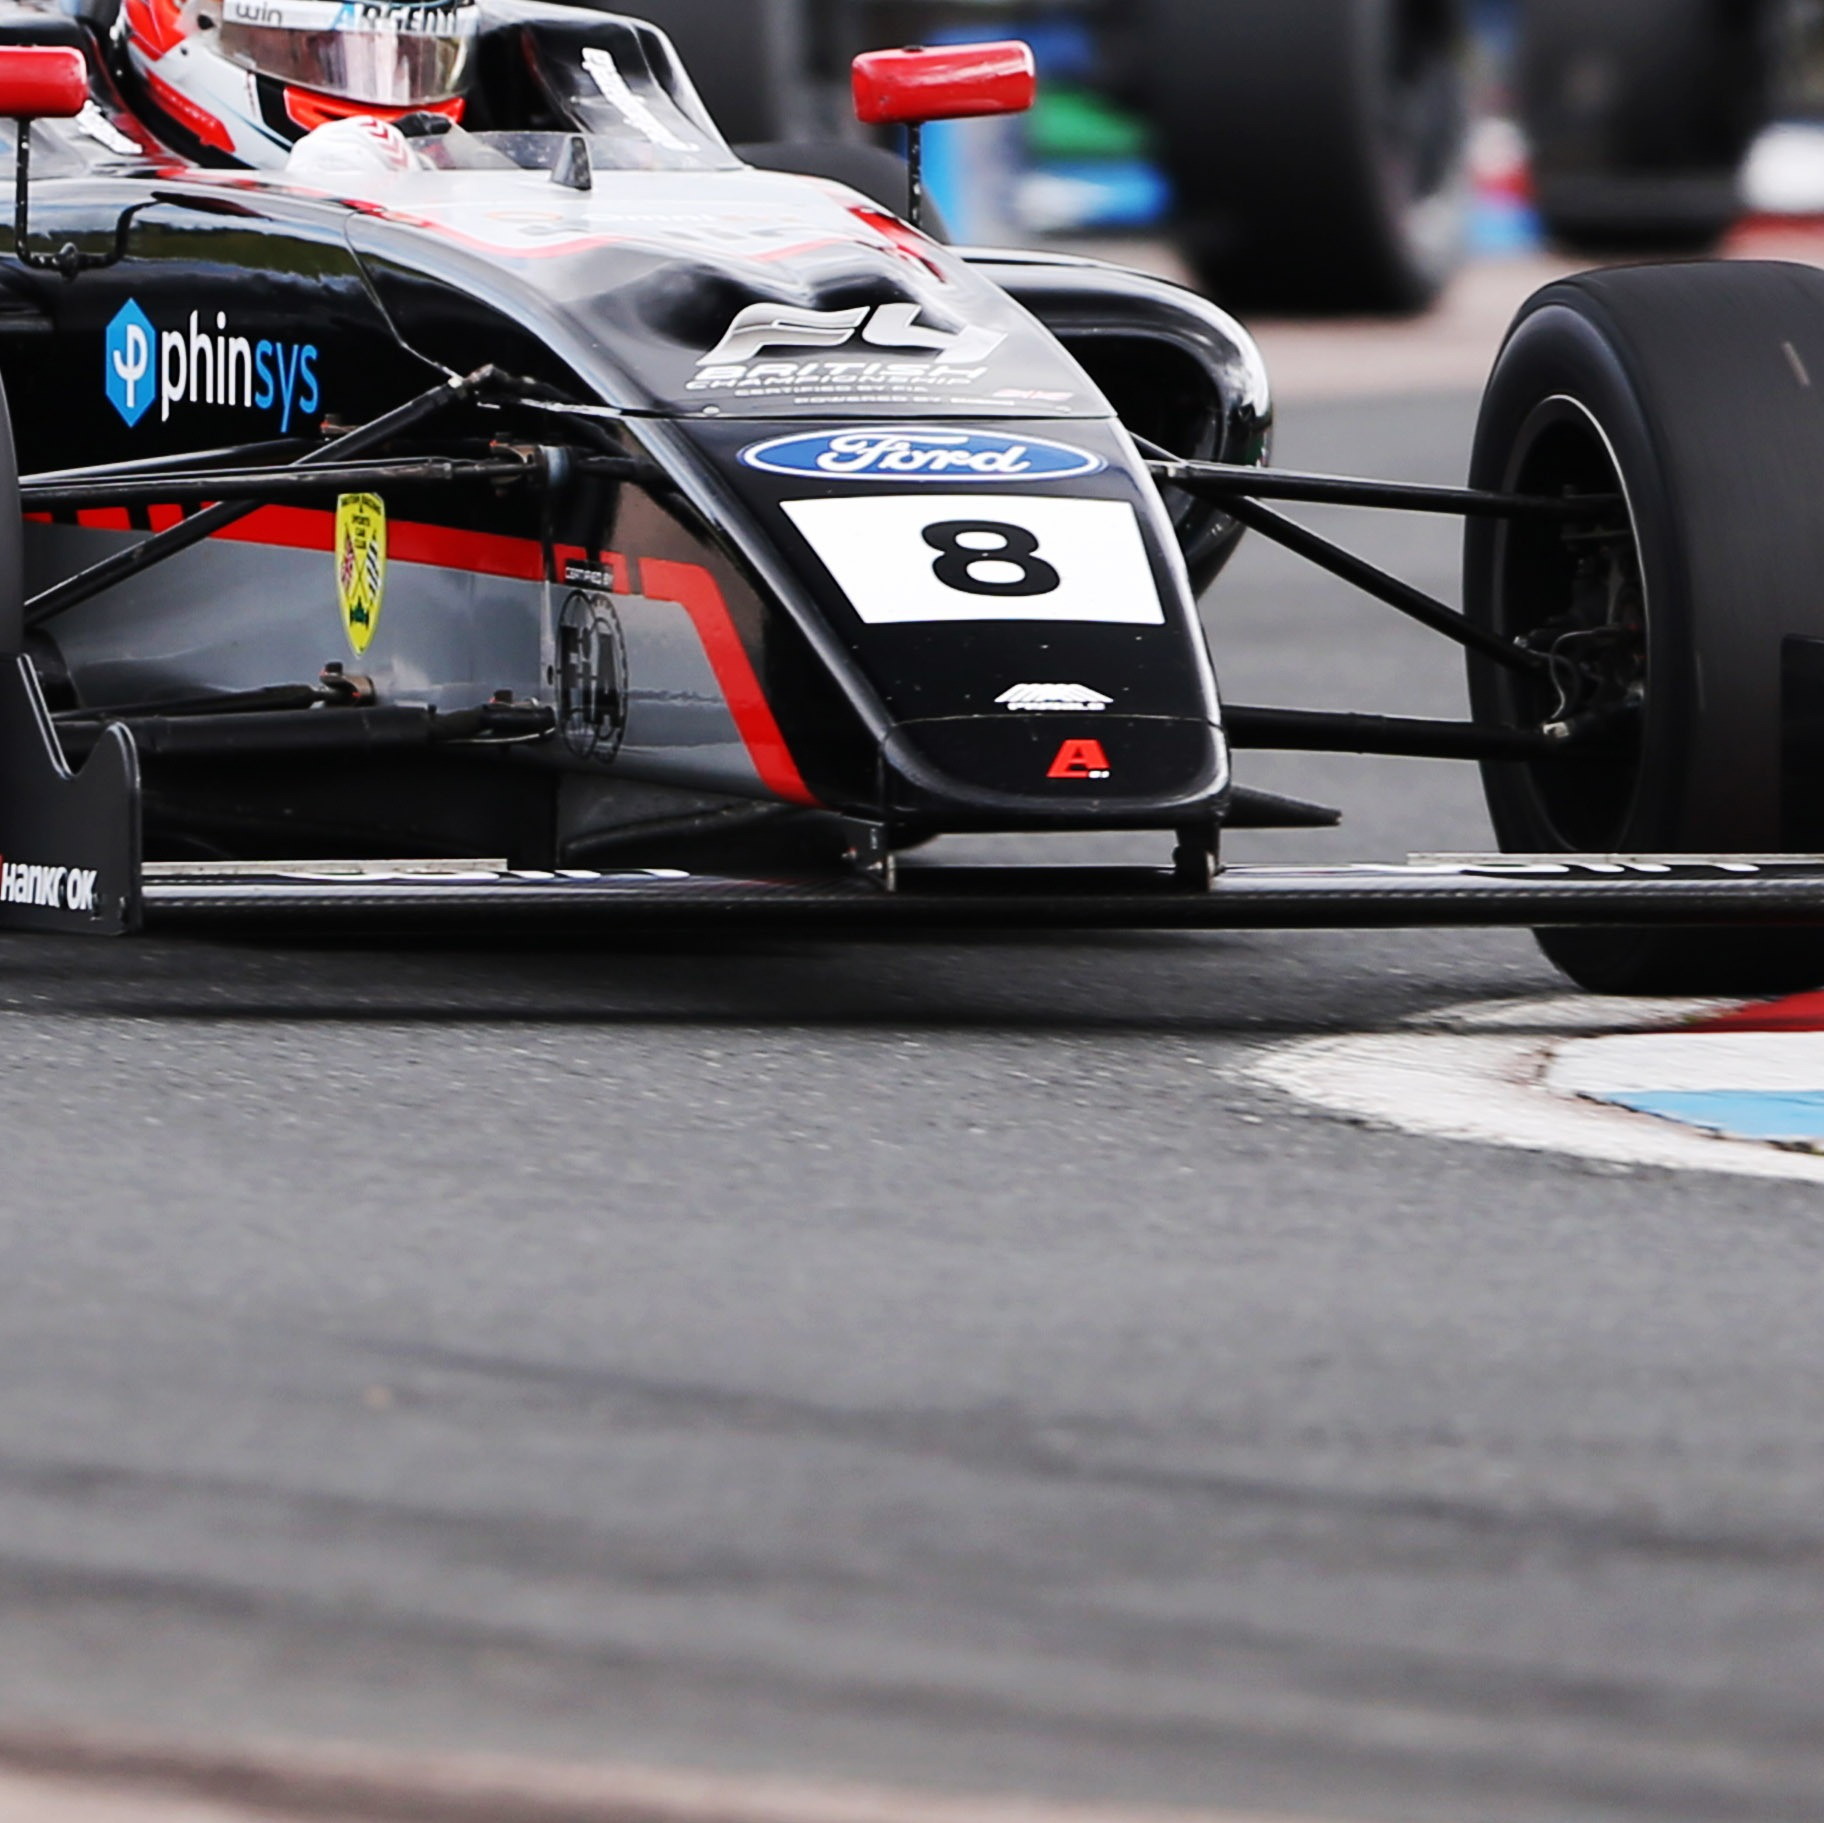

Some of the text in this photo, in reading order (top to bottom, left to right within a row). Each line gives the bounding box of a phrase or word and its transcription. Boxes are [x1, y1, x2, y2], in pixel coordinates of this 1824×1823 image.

[235, 2, 283, 25] win
[696, 302, 1008, 366] F4
[161, 309, 319, 433] phinsys
[685, 374, 975, 390] CHAMPIONSHIP
[695, 362, 988, 382] BRITISH
[816, 433, 1031, 474] Ford
[921, 519, 1061, 596] 8
